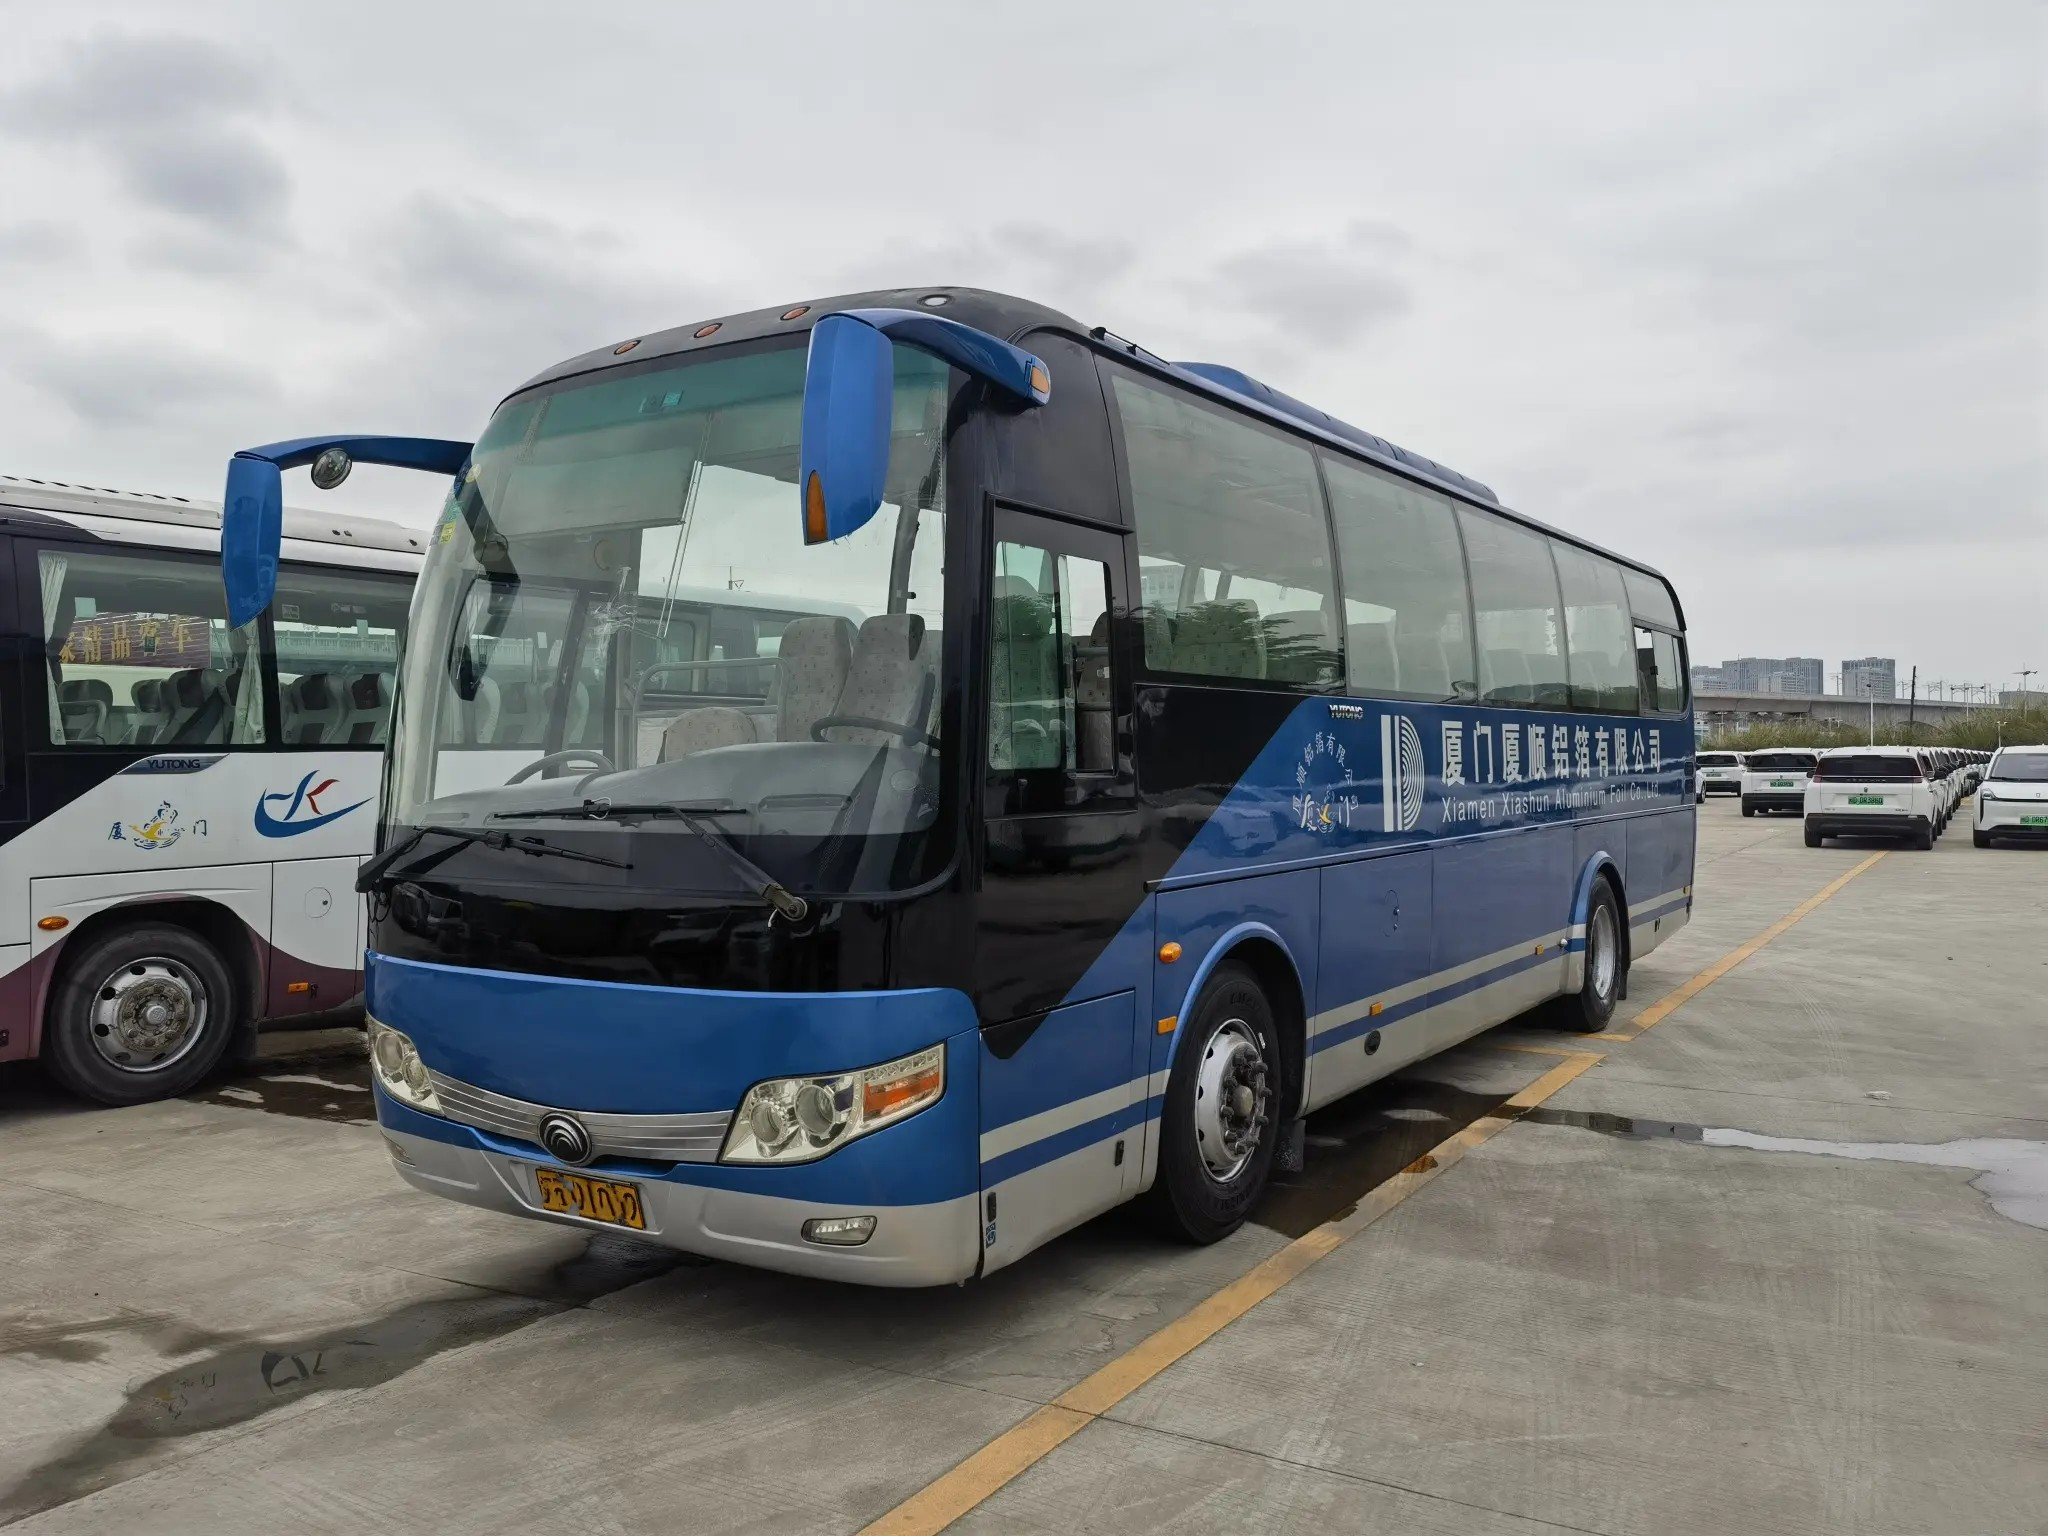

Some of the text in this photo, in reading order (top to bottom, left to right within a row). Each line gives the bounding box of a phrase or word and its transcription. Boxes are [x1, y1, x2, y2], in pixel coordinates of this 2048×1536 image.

[1328, 704, 1363, 719] YUTONG
[147, 759, 200, 769] YUTONG
[1441, 720, 1660, 787] 厦门厦顺铝箔有限公司
[1441, 796, 1495, 823] Xiamen
[1502, 792, 1550, 816] Xiashun
[1555, 786, 1606, 810] Aluminium
[1610, 783, 1627, 803] Foil
